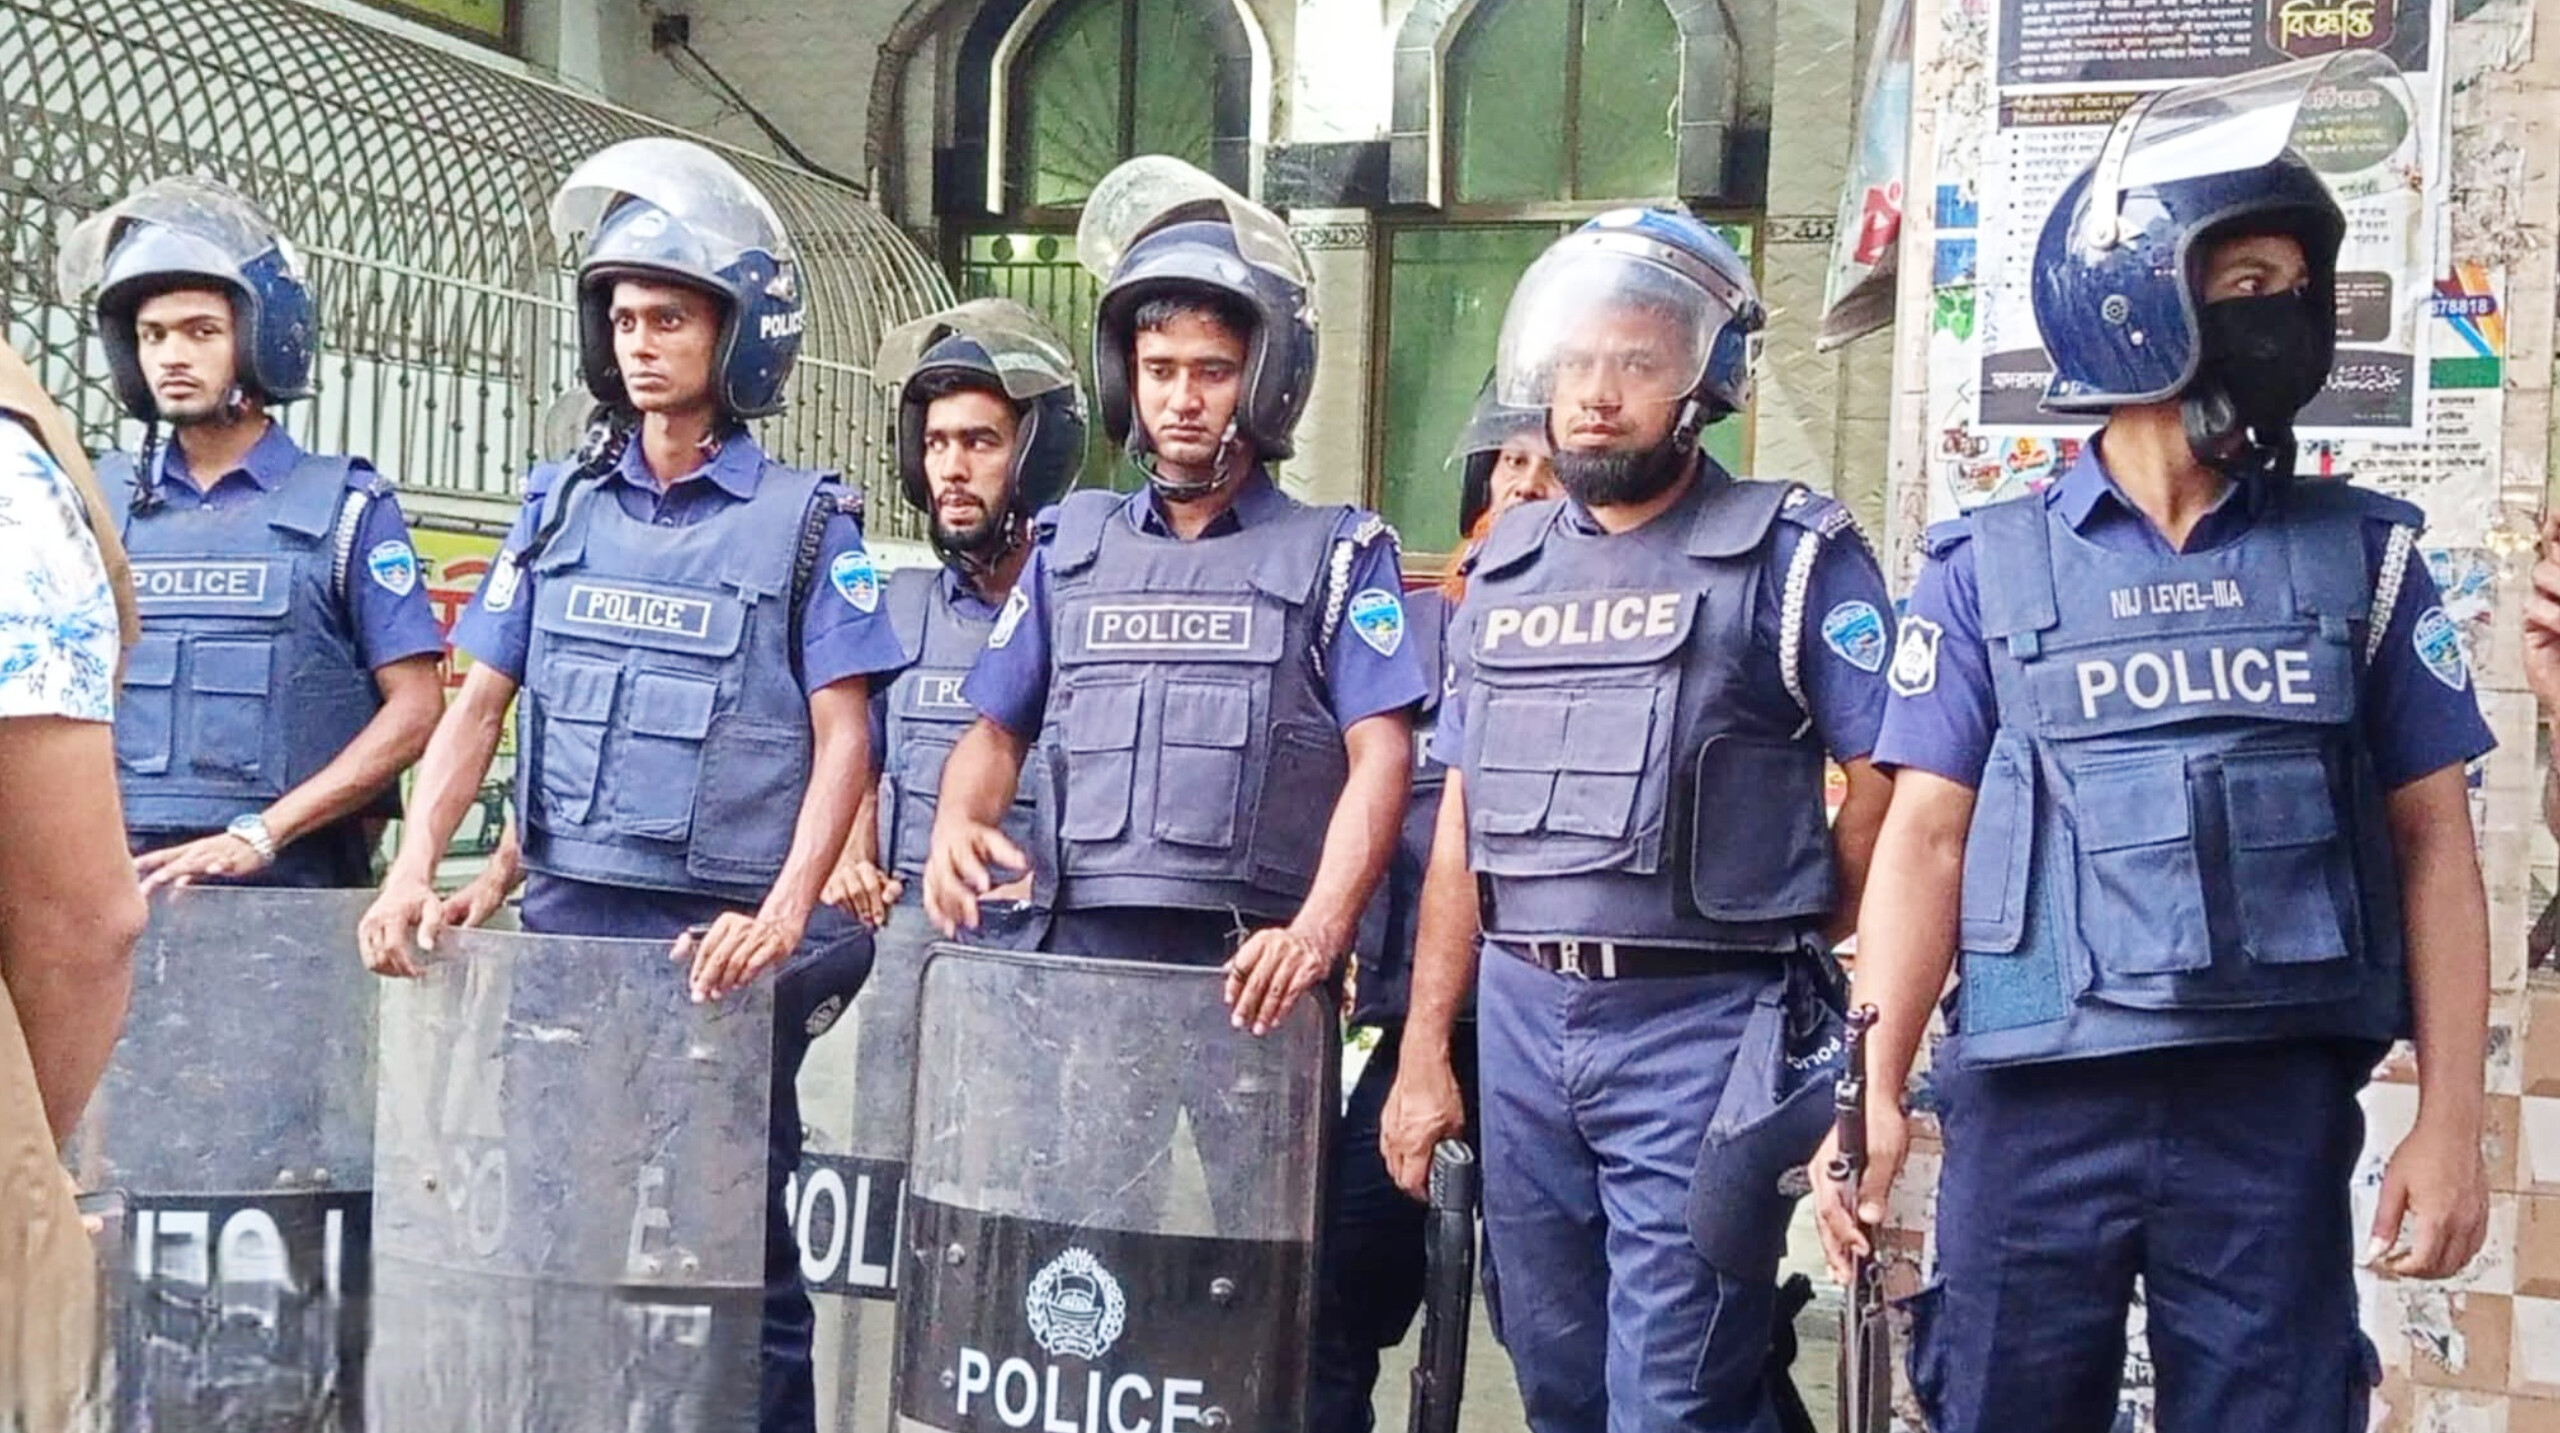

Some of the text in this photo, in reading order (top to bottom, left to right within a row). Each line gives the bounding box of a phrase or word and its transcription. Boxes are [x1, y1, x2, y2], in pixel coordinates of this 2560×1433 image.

[761, 311, 806, 339] POLIC
[132, 569, 249, 595] POLICE
[586, 590, 686, 631] POLICE
[2110, 586, 2142, 619] NIJ
[1102, 612, 1232, 641] POLICE
[1484, 593, 1681, 650] POLICE
[2076, 646, 2317, 719] POLICE
[956, 1347, 1203, 1433] POLICE
